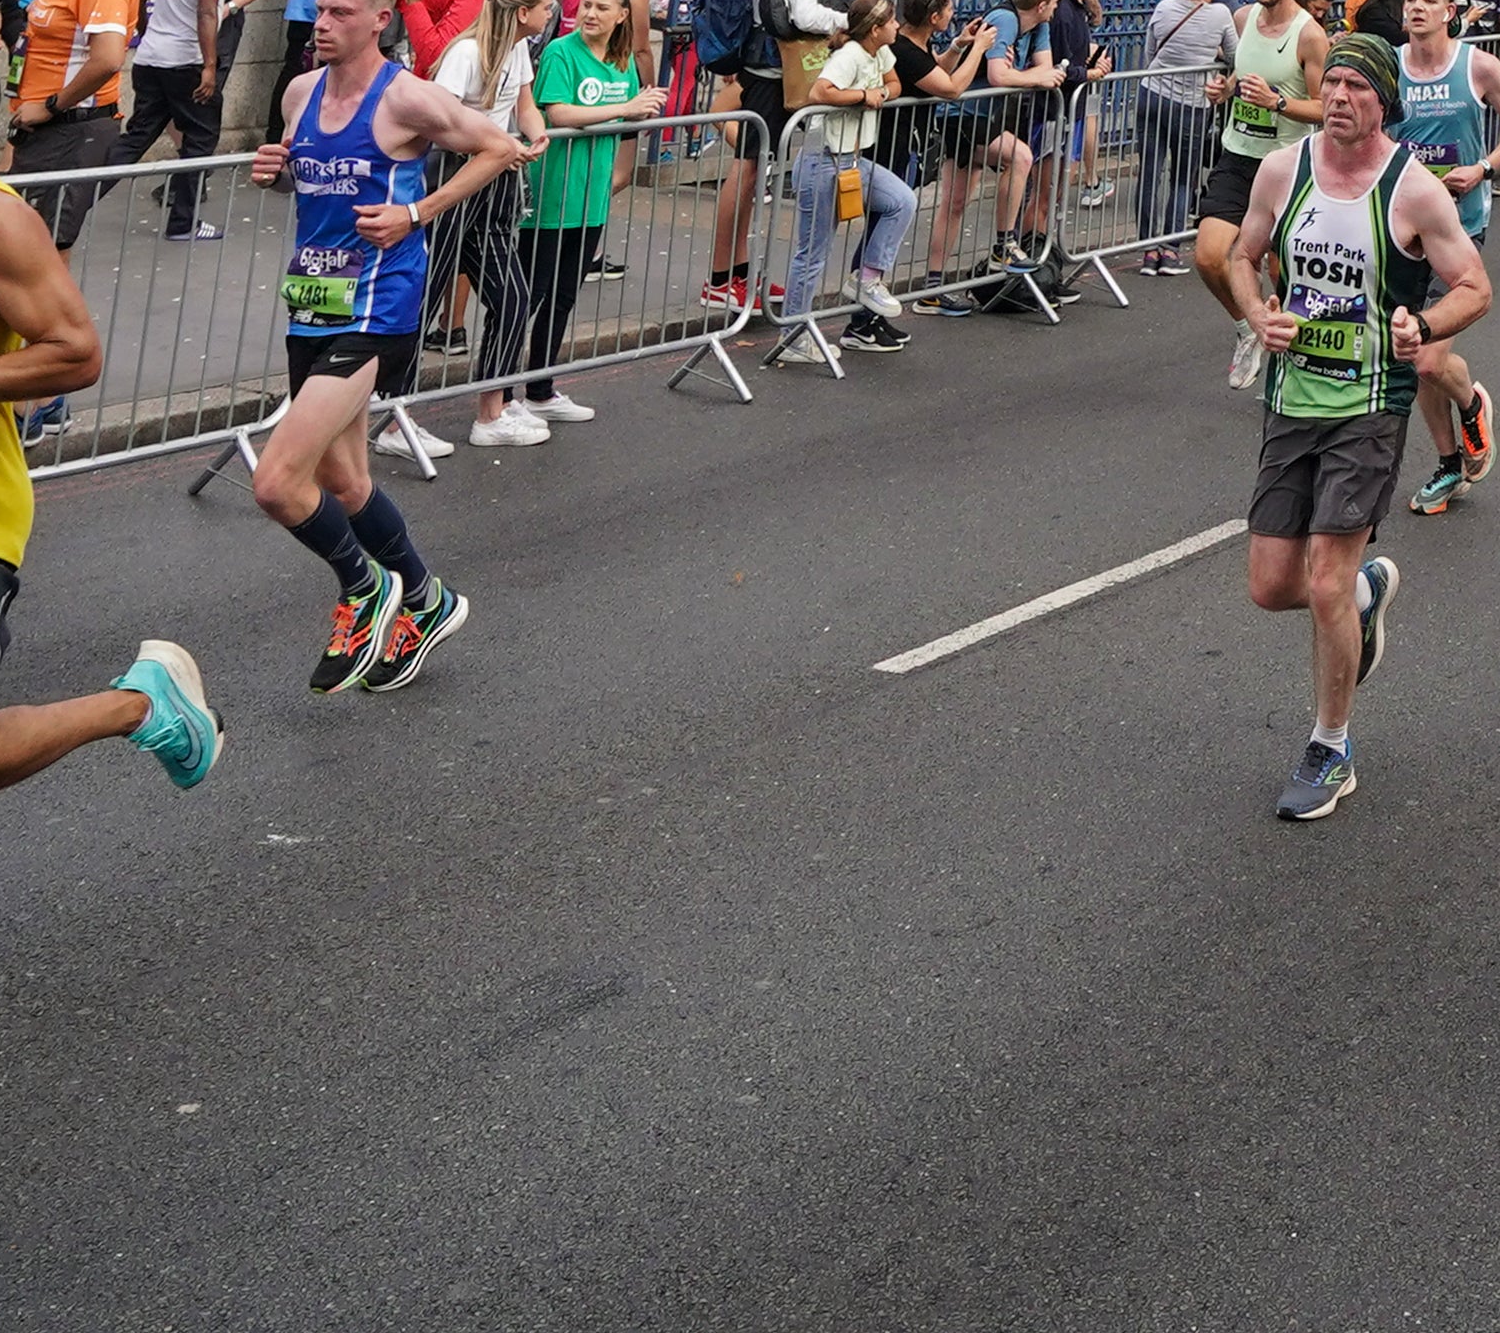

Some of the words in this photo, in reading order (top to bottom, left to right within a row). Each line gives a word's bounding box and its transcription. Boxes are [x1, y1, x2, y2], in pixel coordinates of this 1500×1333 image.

[1406, 84, 1450, 102] MAXI
[1442, 100, 1468, 109] Health
[294, 159, 359, 185] DORSET
[1294, 238, 1330, 254] Trent
[1334, 243, 1366, 263] Park
[1294, 255, 1364, 290] TOSH
[1297, 326, 1345, 352] 12140
